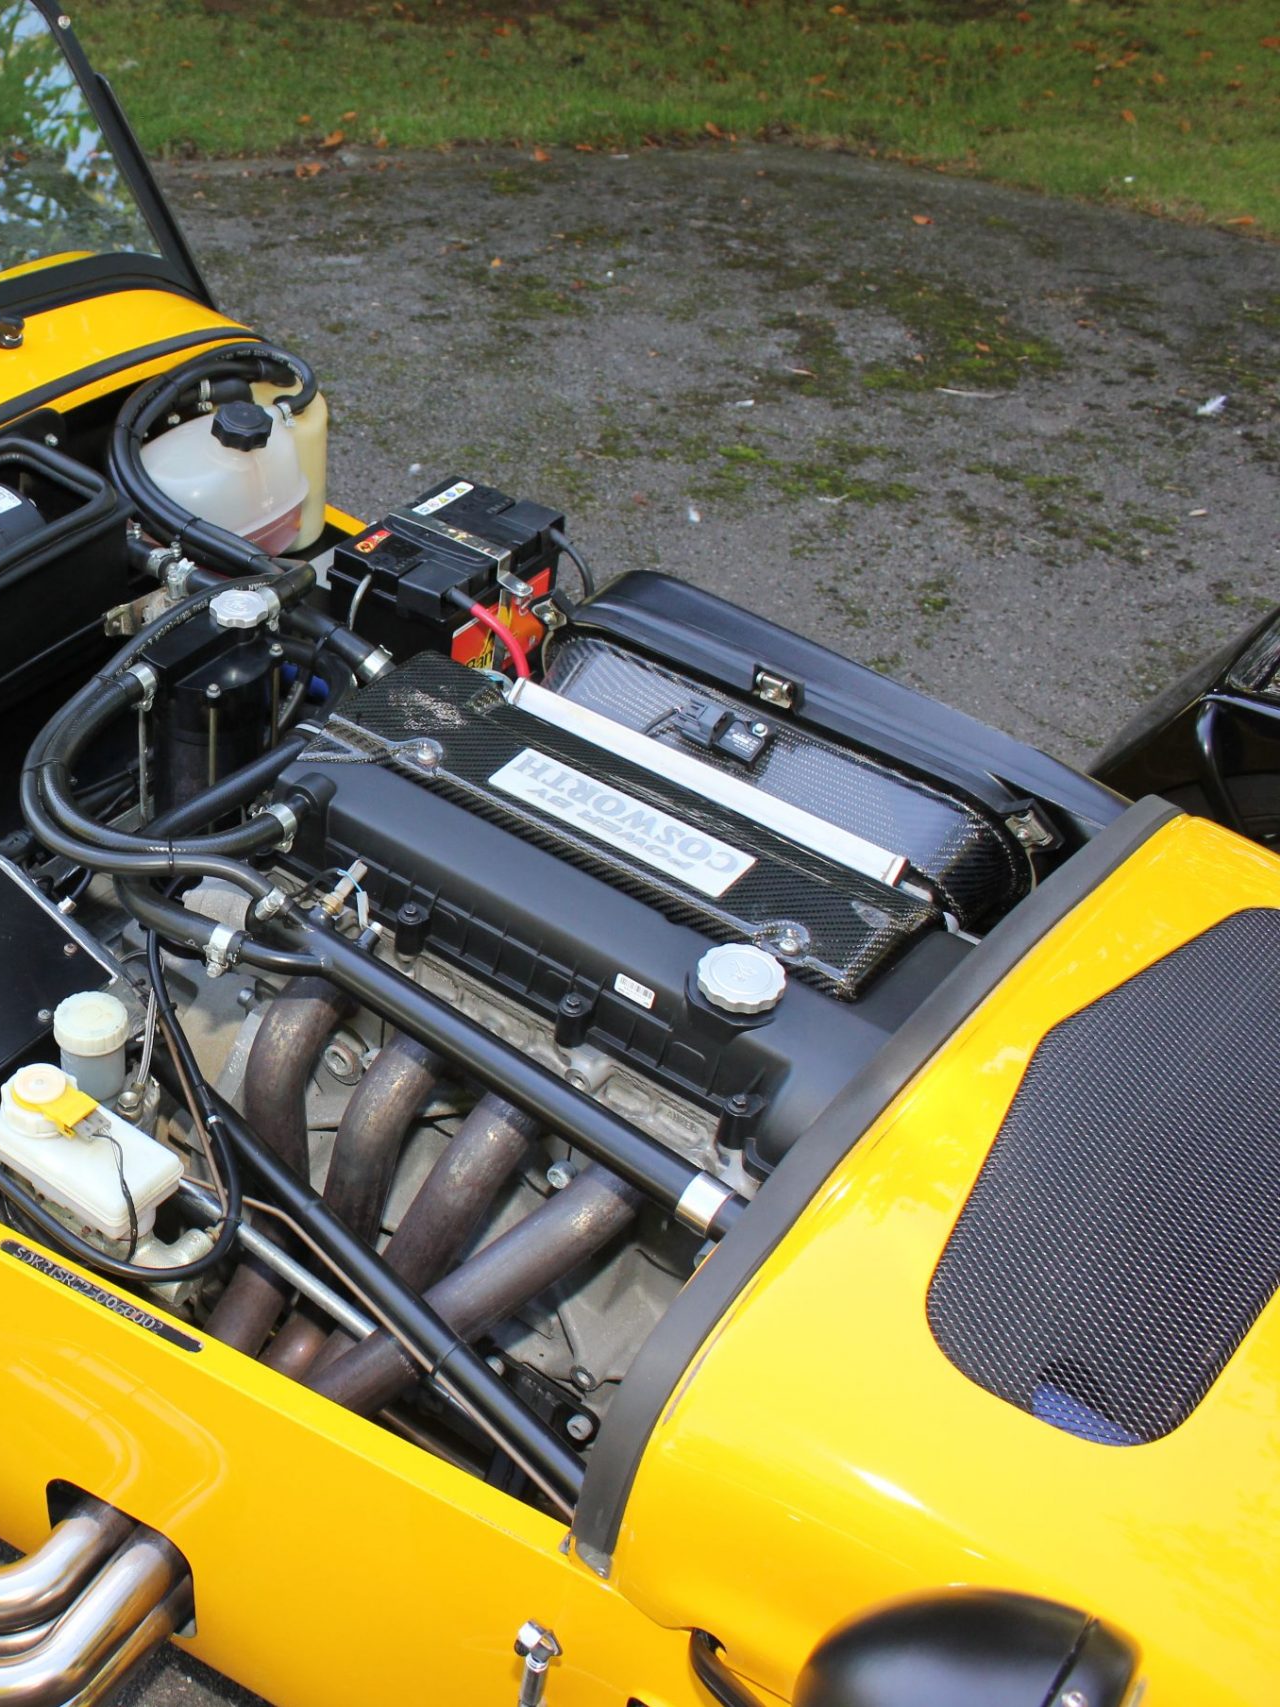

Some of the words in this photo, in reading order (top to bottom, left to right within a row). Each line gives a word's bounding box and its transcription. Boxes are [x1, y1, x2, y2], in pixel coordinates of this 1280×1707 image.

[512, 754, 738, 874] COSWORTH
[526, 787, 574, 809] BY
[577, 808, 696, 871] POWER
